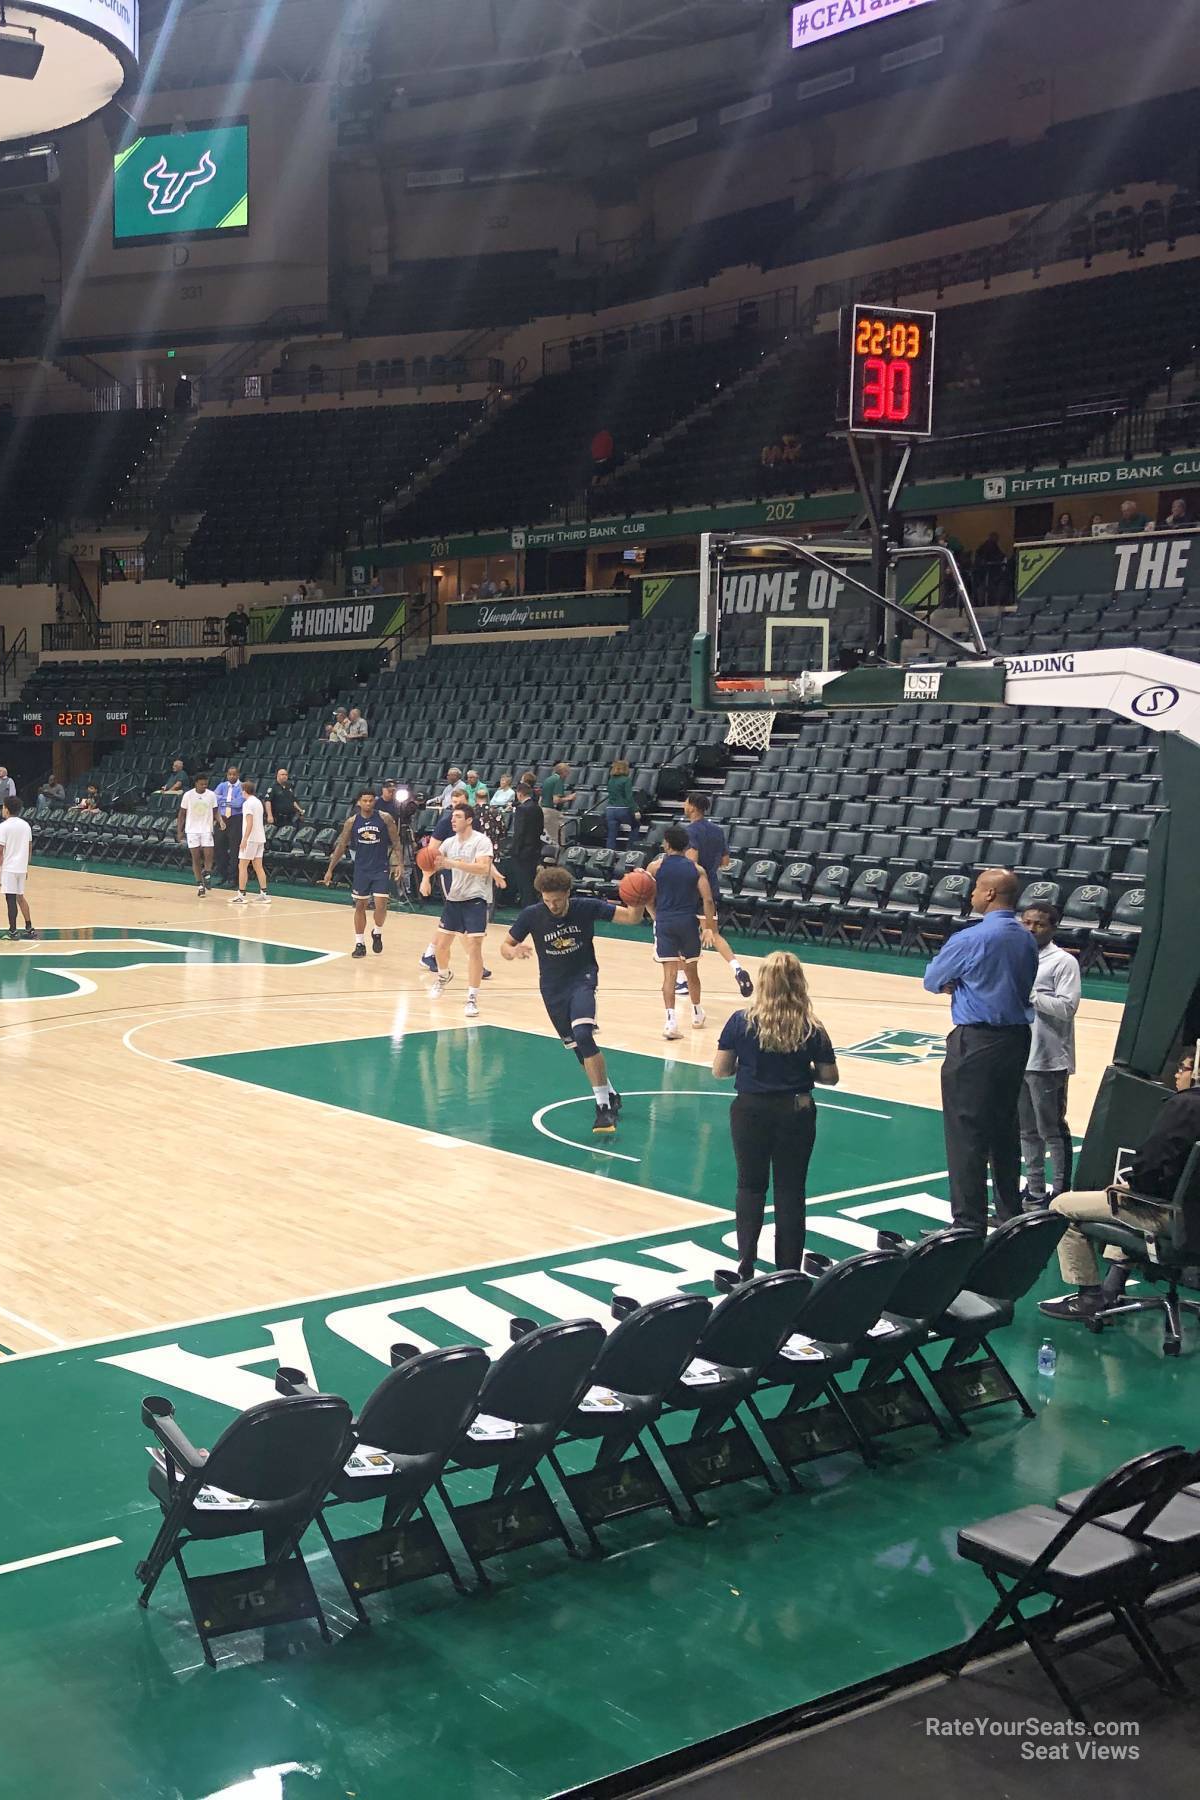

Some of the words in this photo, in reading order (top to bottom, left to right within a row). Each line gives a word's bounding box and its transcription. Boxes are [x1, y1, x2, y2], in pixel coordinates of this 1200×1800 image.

[174, 246, 190, 266] D
[181, 285, 203, 300] 331
[857, 320, 920, 358] 22:03
[863, 358, 911, 420] 30
[1011, 477, 1056, 493] FIFTH
[1060, 471, 1111, 487] THIRD
[1116, 465, 1164, 481] BANK
[766, 503, 795, 521] 202
[528, 532, 555, 544] FIFTH
[557, 530, 587, 542] THIRD
[589, 526, 617, 538] BANK
[623, 523, 645, 534] CLUB
[71, 545, 94, 557] 221
[430, 542, 449, 558] 201
[1114, 540, 1192, 591] THE
[722, 571, 800, 615] HOME
[807, 567, 847, 609] OF
[290, 604, 375, 637] #HORNSUP
[478, 605, 530, 627] Yuengling
[529, 610, 565, 620] CENTER
[1001, 654, 1075, 675] PALDING
[907, 674, 939, 690] USF
[903, 690, 939, 700] HEALTH
[23, 713, 43, 721] HOME
[57, 713, 93, 726] 22:03
[106, 712, 128, 721] GUEST
[34, 723, 43, 737] 0
[120, 723, 128, 737] 0
[602, 1484, 627, 1501] 73
[492, 1514, 519, 1533] 74
[376, 1550, 404, 1571] 75
[233, 1590, 265, 1610] 76
